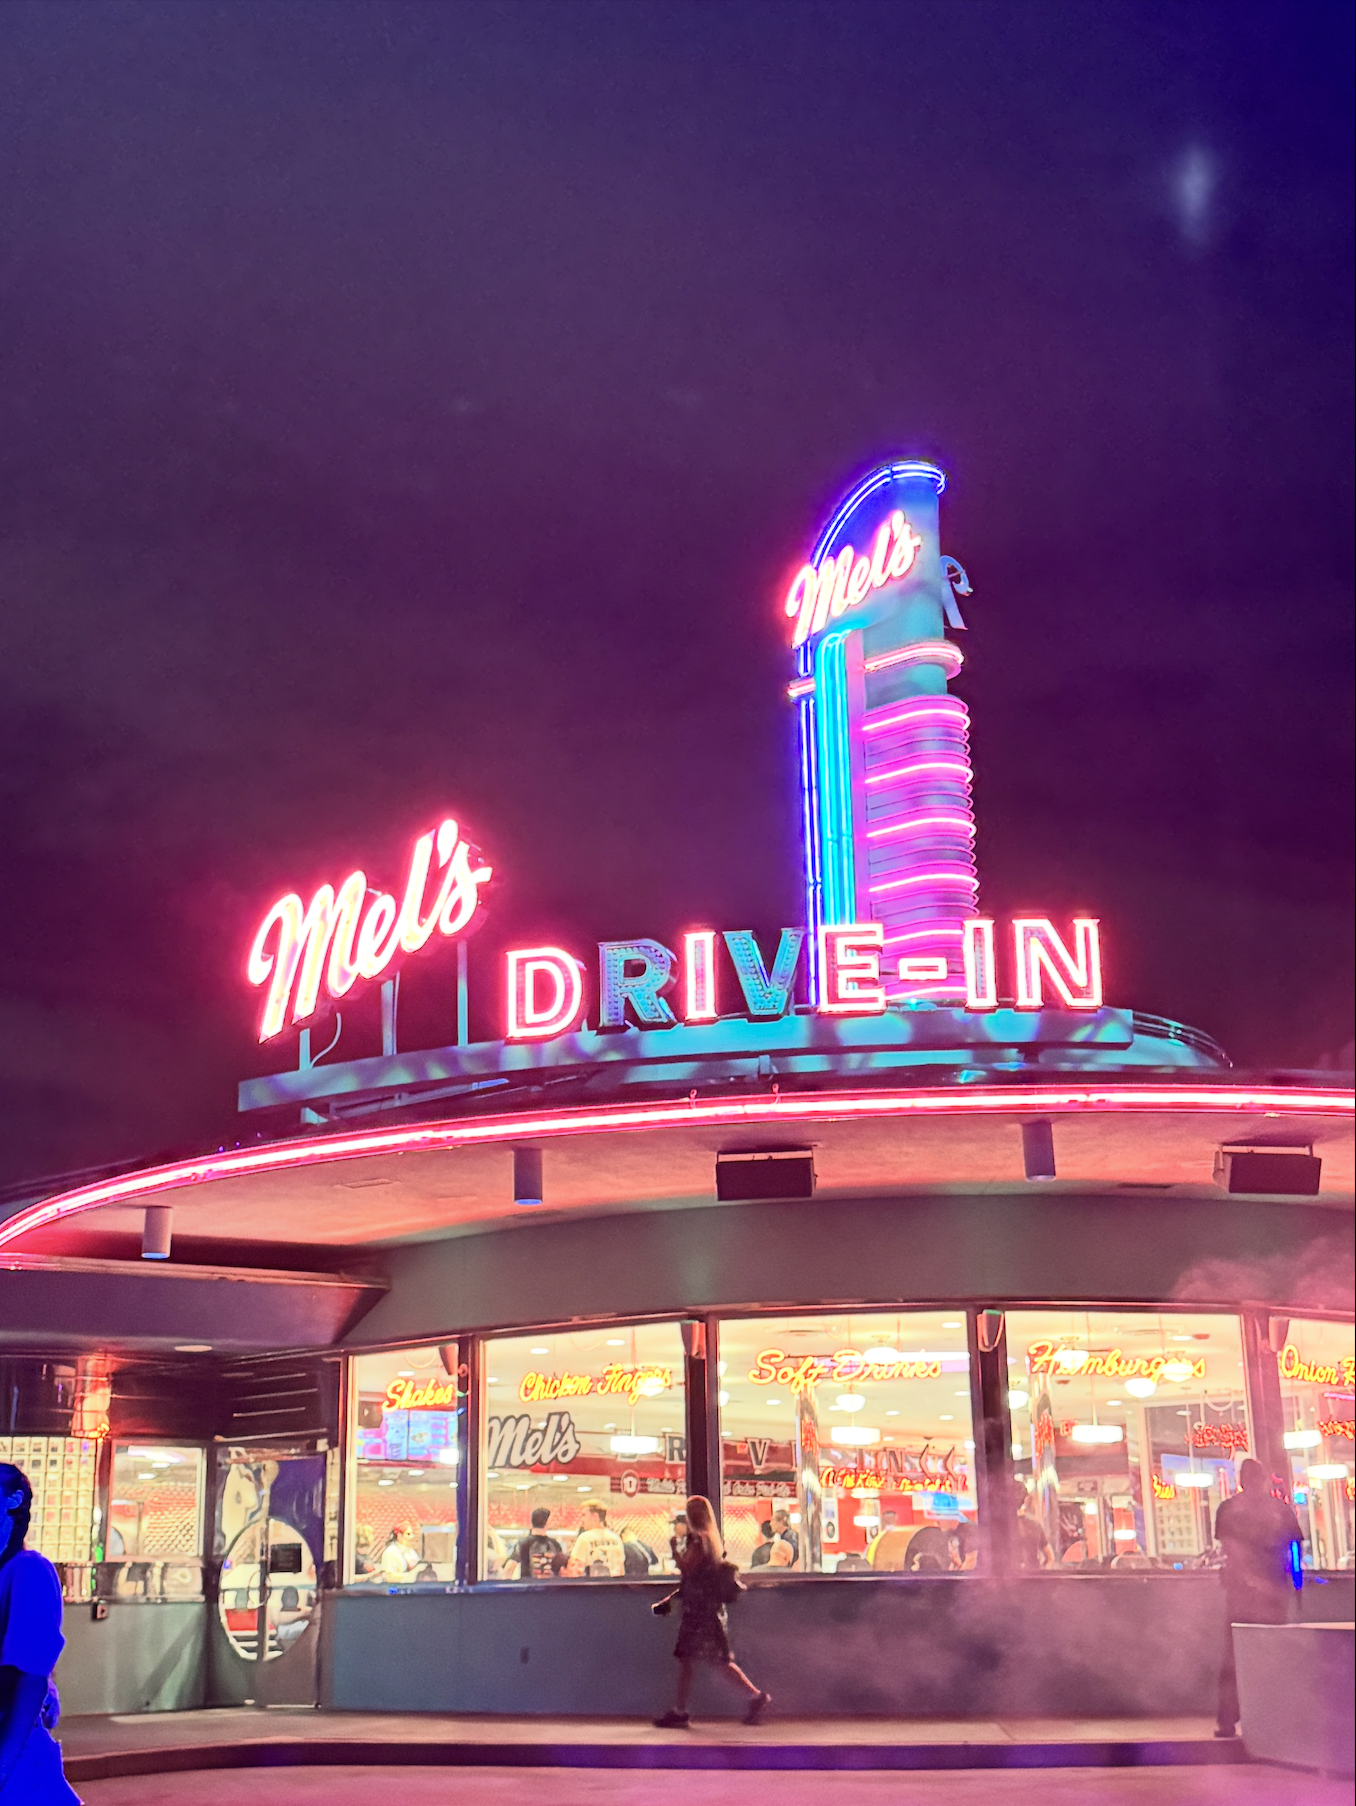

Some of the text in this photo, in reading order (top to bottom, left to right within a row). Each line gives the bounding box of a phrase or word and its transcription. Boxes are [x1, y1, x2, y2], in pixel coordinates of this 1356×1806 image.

[784, 509, 922, 649] Mel's
[247, 818, 494, 1045] Mel's
[504, 917, 1104, 1040] DRIVE-IN
[519, 1370, 593, 1403] Chicken
[747, 1348, 943, 1395] Soft Drinks
[1280, 1344, 1340, 1385] Onion
[381, 1377, 454, 1413] Shakes
[487, 1411, 582, 1469] Mel's
